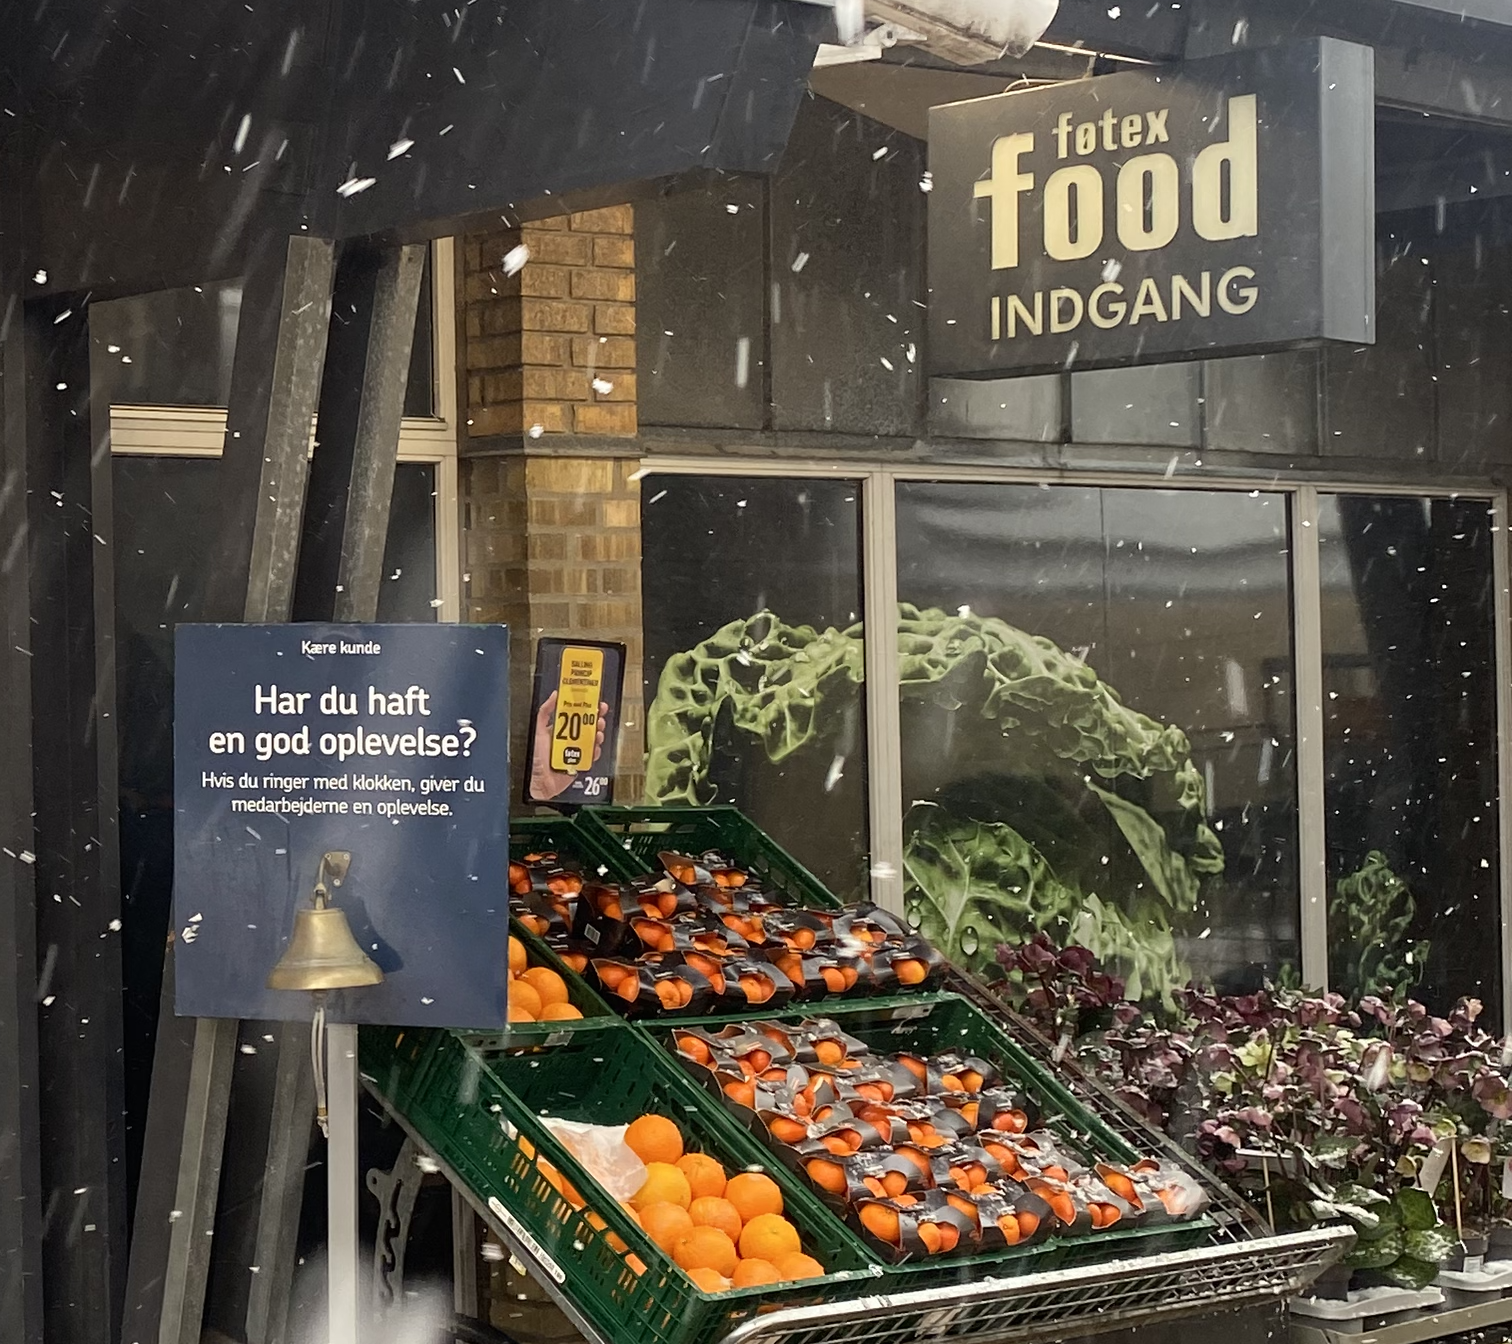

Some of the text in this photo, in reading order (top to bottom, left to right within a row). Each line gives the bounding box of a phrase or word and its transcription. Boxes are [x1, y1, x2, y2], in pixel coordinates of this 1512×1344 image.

[1051, 108, 1170, 159] føtex
[973, 94, 1258, 271] food
[990, 266, 1260, 341] INDGANG
[301, 640, 381, 654] Kære kunde
[254, 685, 431, 716] Har du haft
[209, 726, 478, 762] en god oplevelse?
[201, 771, 485, 795] Hvis du ringer med klokken, giver du
[231, 796, 453, 818] medarbejderne en oplevelse.
